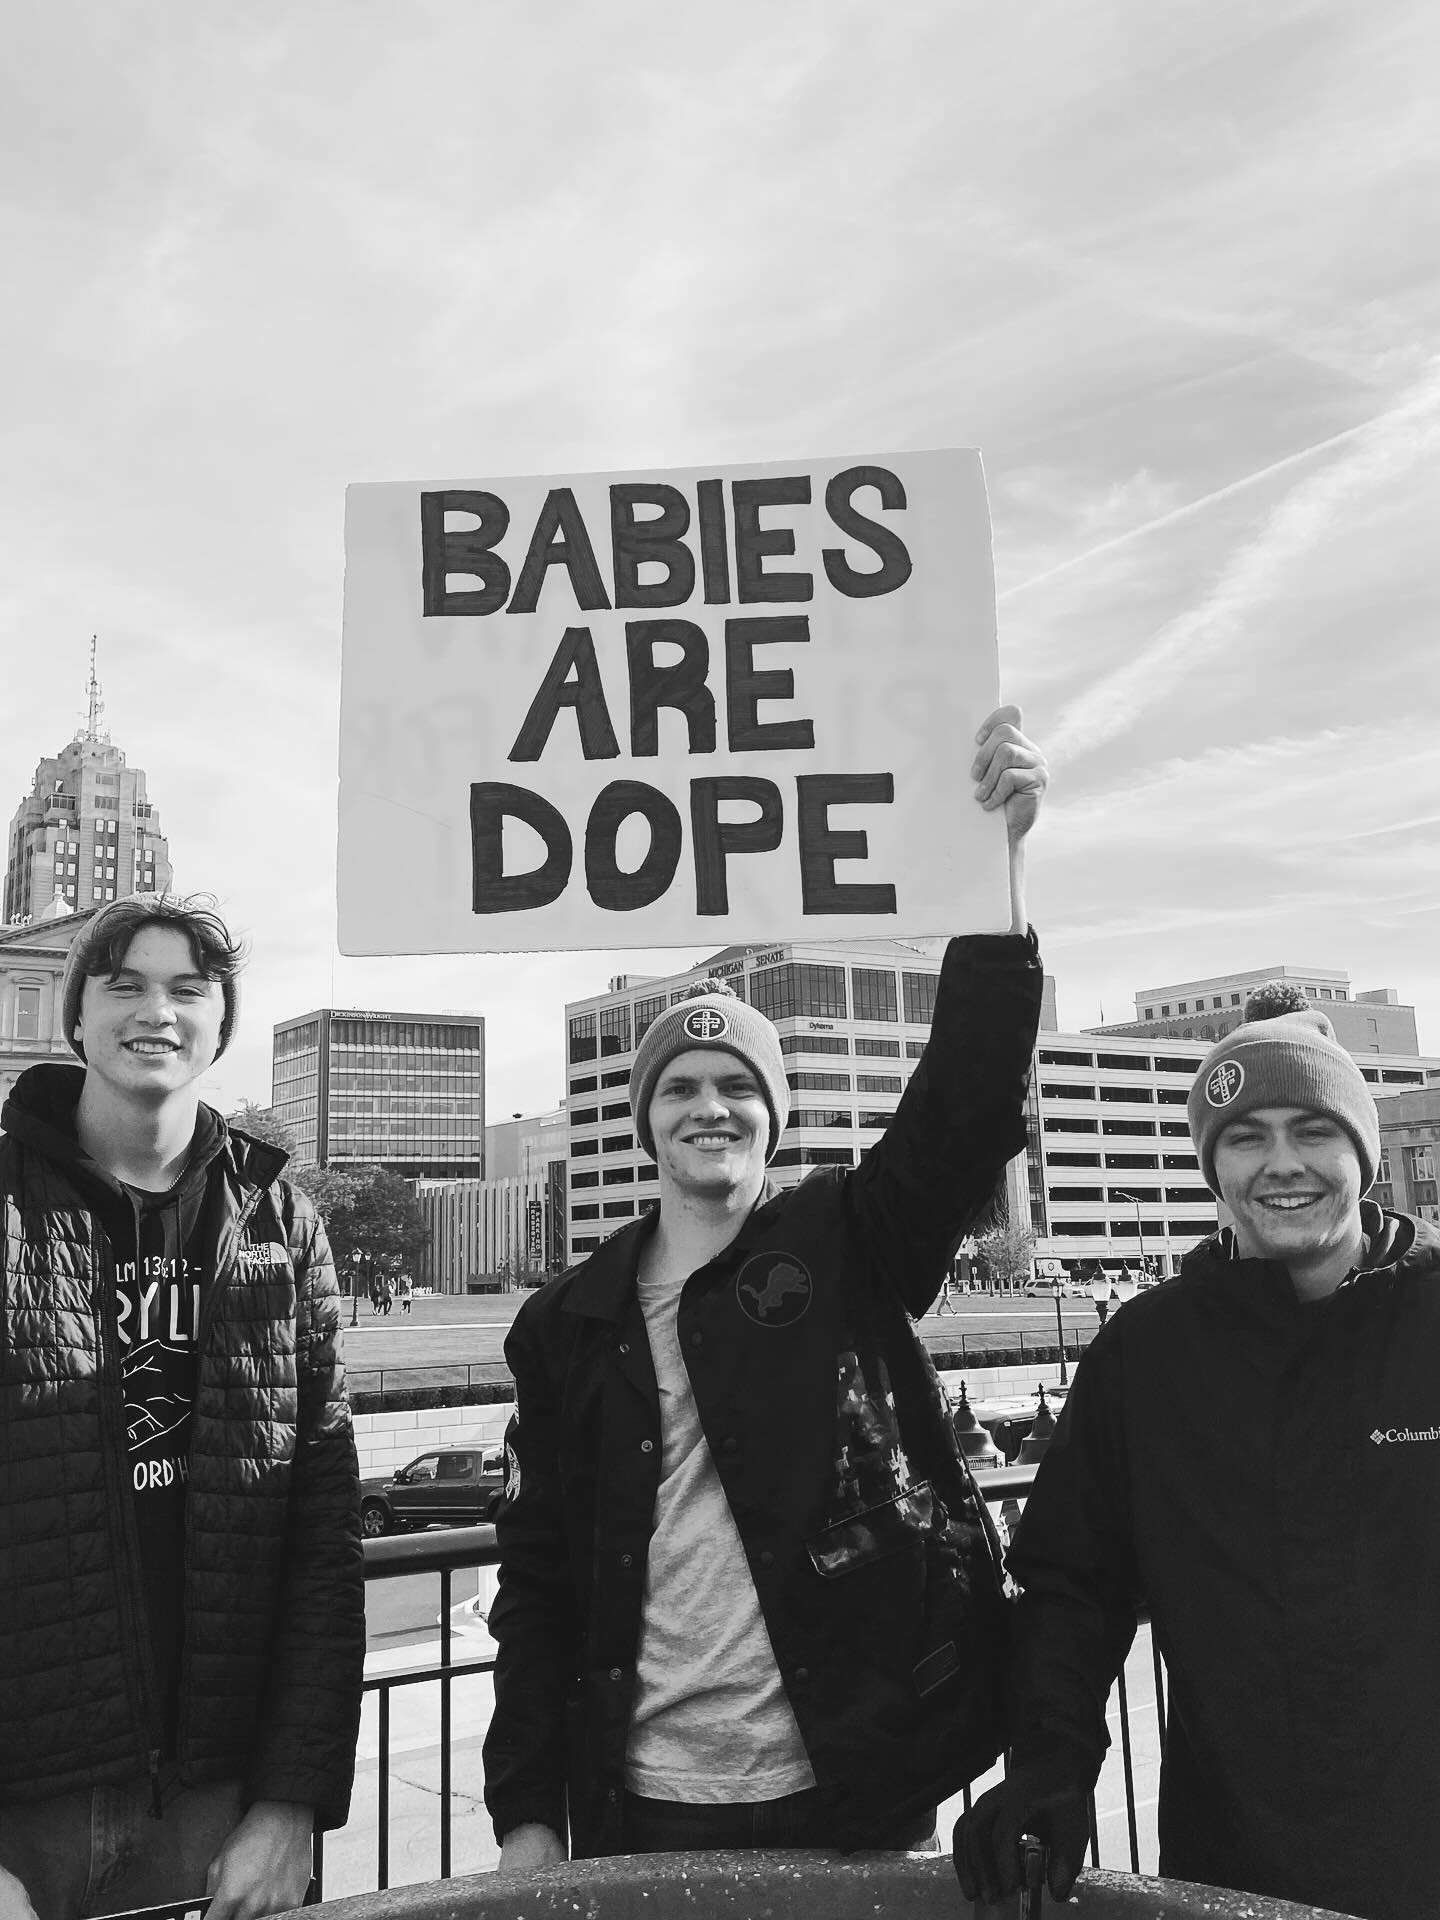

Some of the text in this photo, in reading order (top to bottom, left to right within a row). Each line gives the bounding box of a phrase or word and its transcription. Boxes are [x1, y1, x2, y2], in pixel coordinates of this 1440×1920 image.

[421, 466, 912, 617] BABIES
[507, 615, 815, 762] ARE
[470, 772, 897, 916] DOPE
[708, 950, 784, 978] MICHIGAN SENATE
[238, 1249, 270, 1258] NORTH
[248, 1256, 271, 1265] FACE
[250, 1242, 270, 1251] THE
